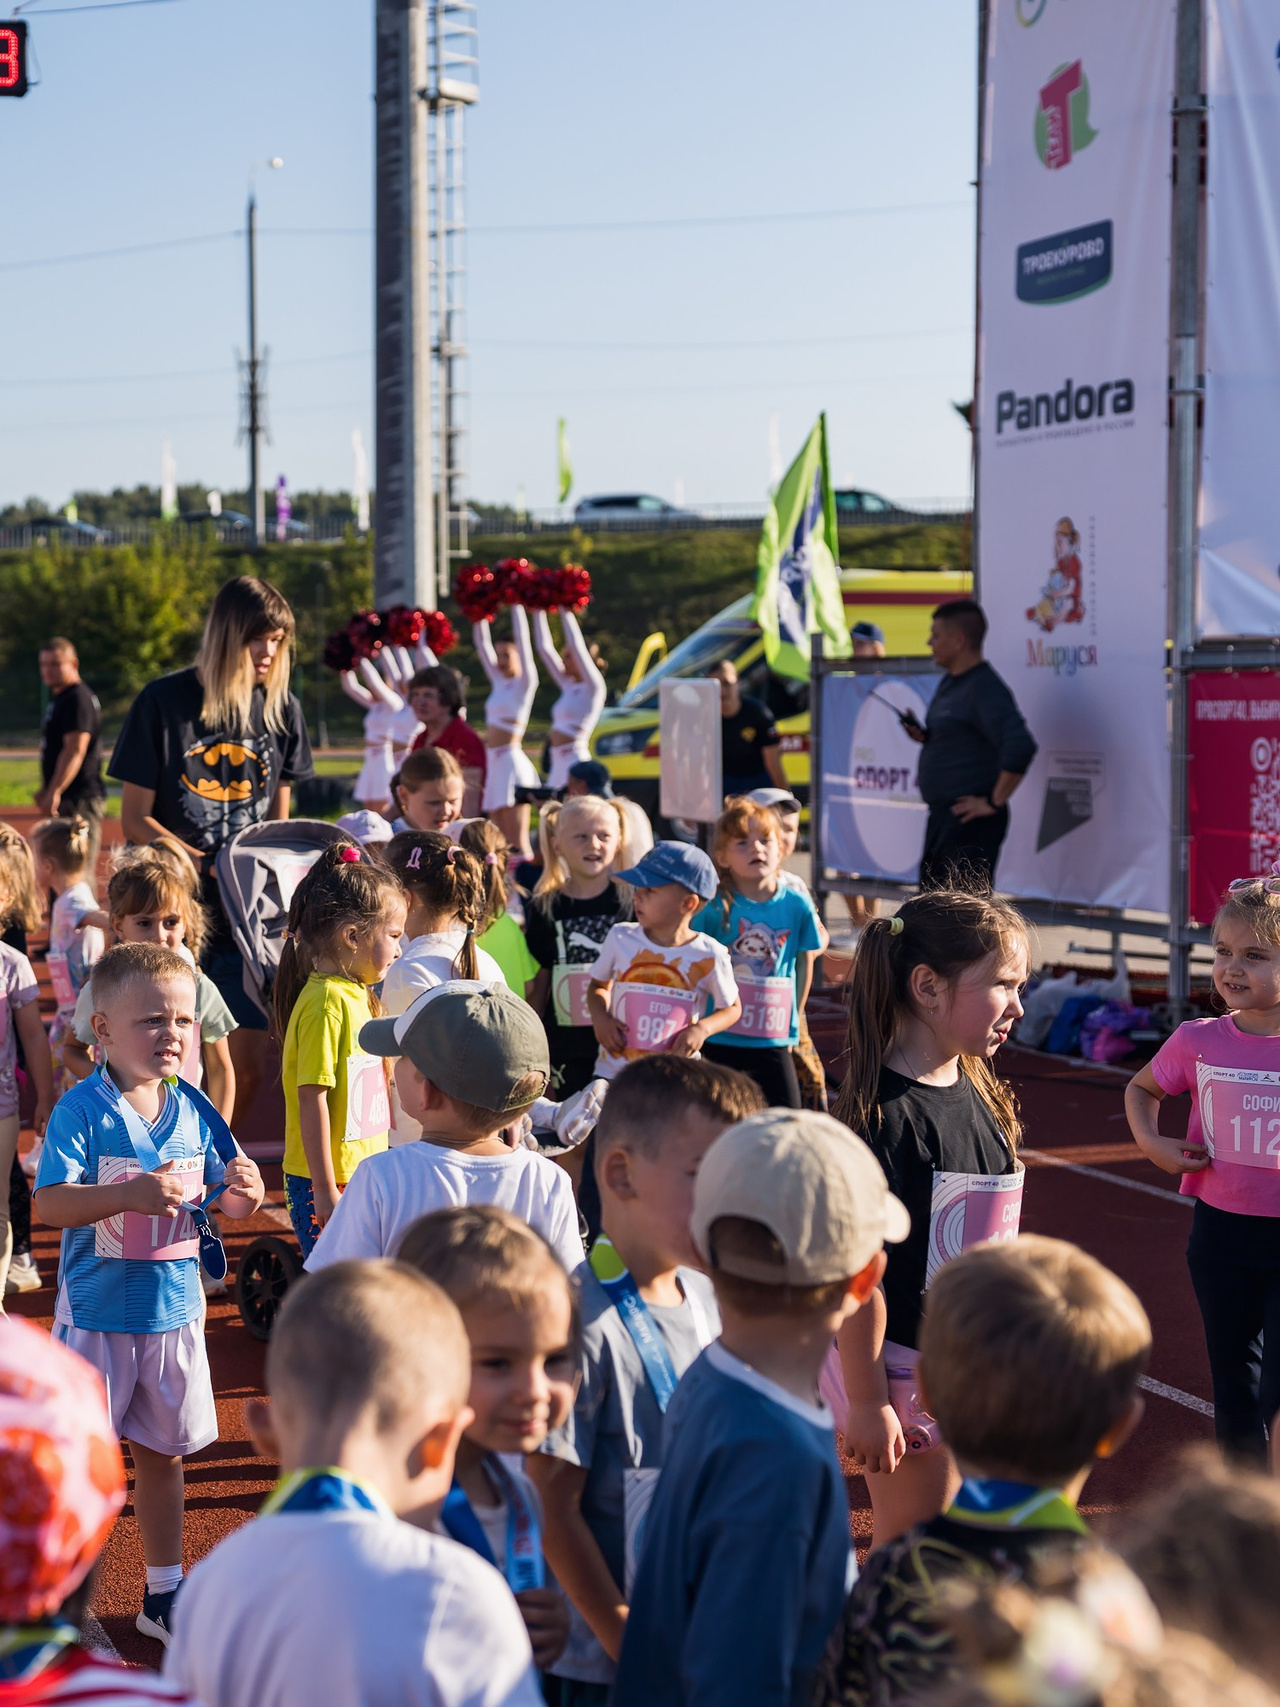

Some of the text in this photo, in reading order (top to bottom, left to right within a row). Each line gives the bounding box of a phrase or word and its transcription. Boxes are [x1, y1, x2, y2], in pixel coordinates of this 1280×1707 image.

[996, 378, 1135, 435] Pandora
[1025, 637, 1098, 677] Маруся
[855, 765, 910, 791] СПОРТ
[637, 1015, 677, 1044] 987
[741, 1004, 787, 1032] 5130
[1230, 1115, 1280, 1156] 112
